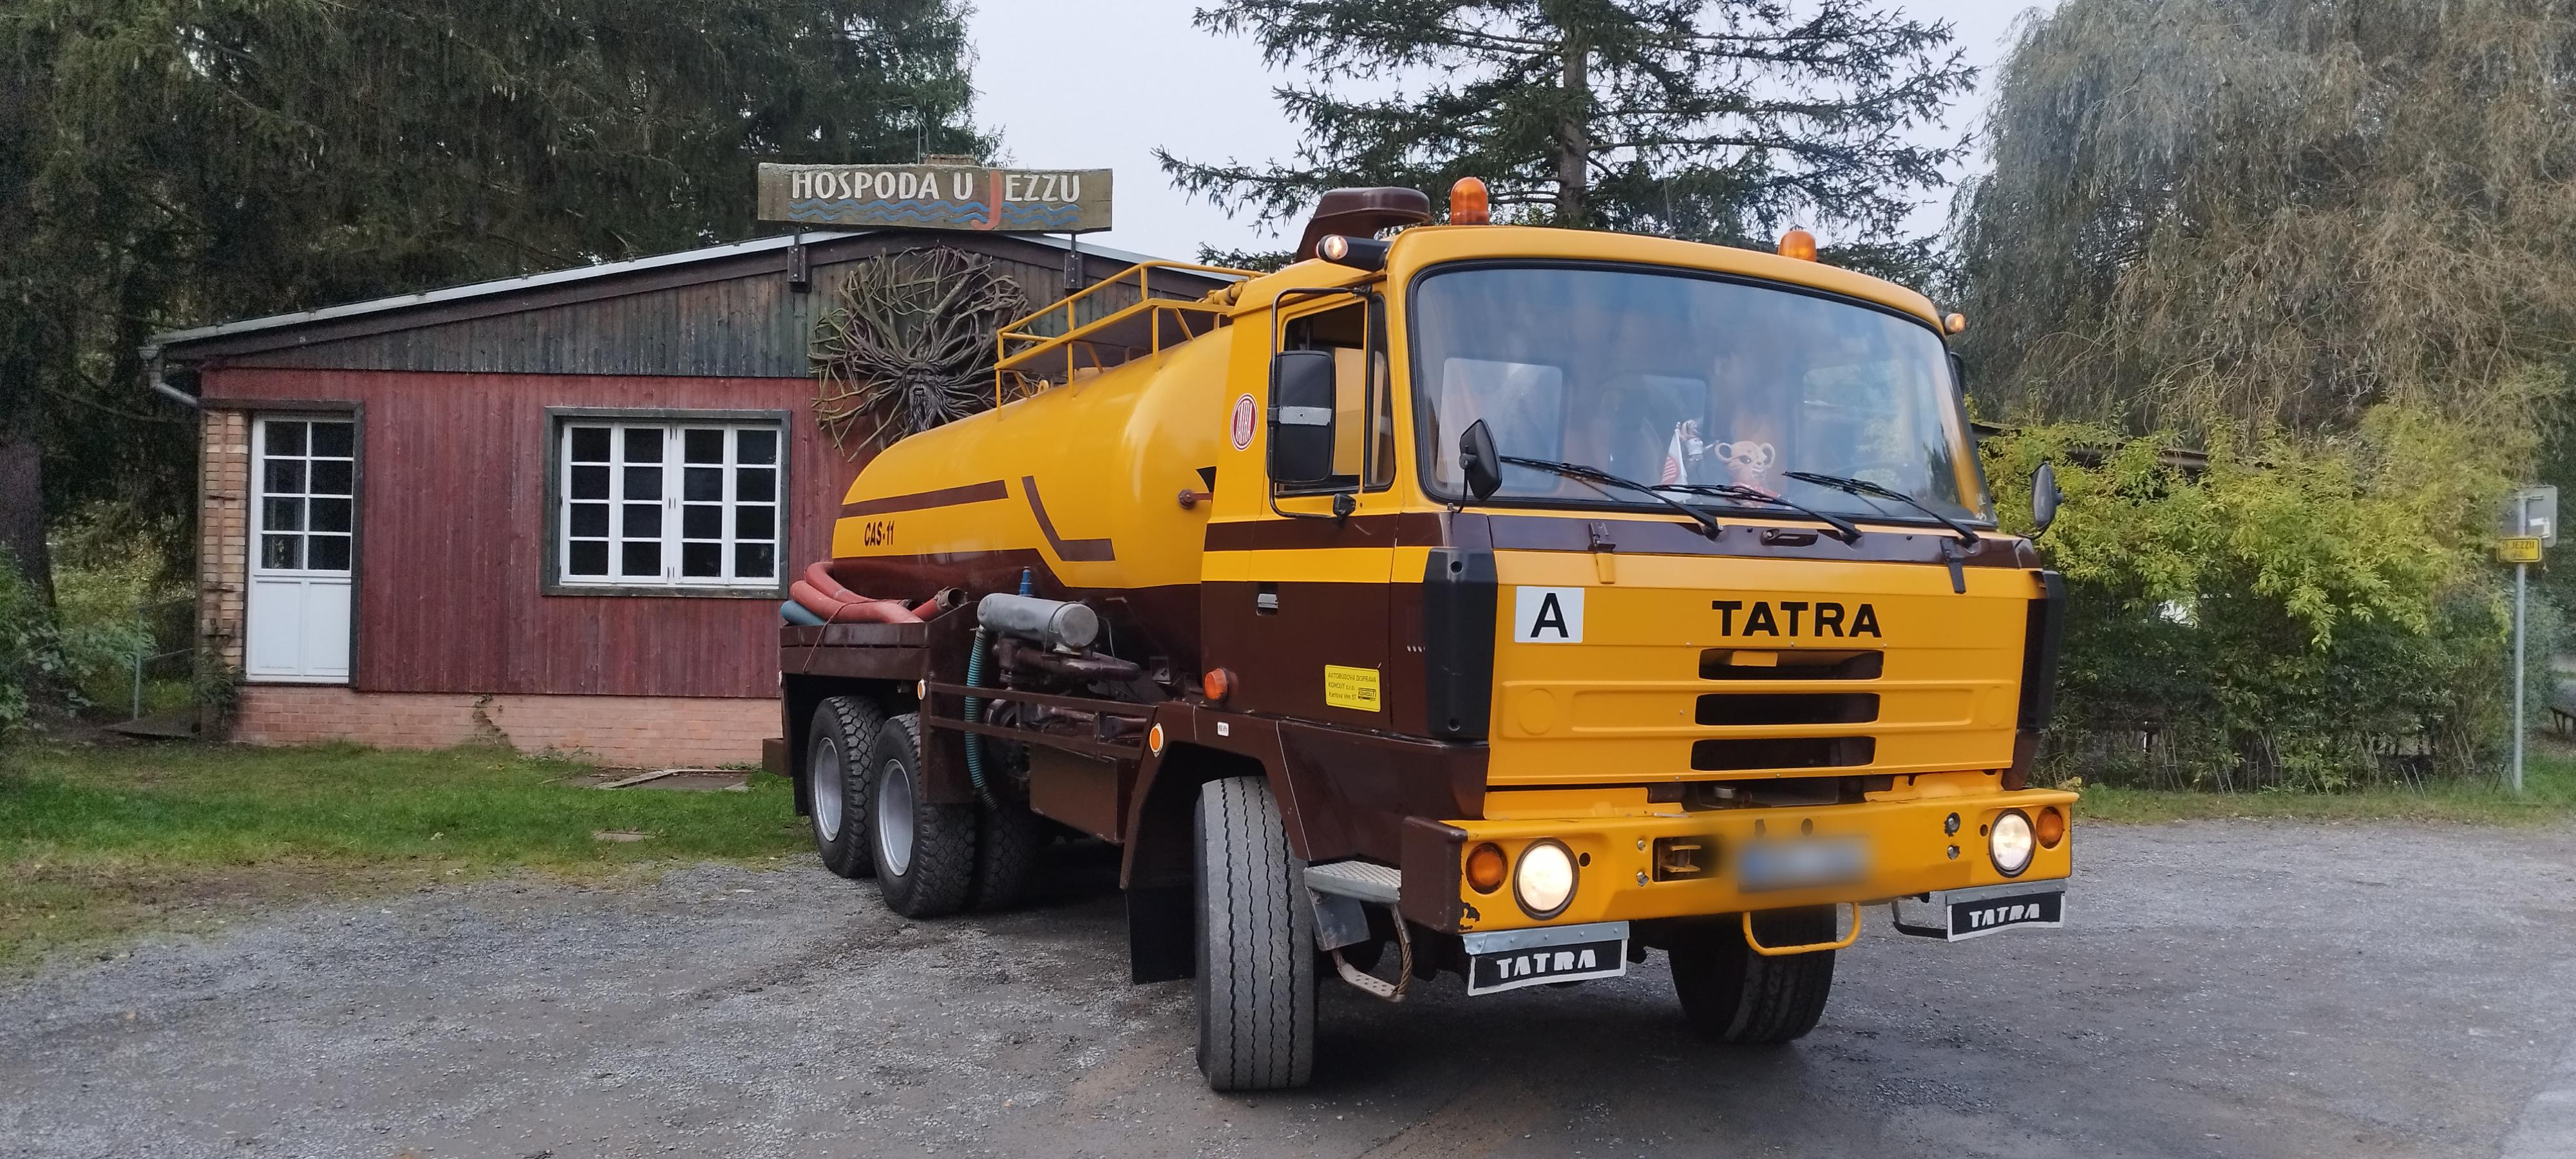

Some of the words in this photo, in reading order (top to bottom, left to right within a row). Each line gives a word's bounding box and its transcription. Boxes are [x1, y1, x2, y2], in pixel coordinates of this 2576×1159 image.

[792, 171, 940, 200] HOSPODA
[954, 172, 973, 200] U
[971, 170, 1080, 231] JEZZU
[1236, 400, 1253, 445] TATRA
[864, 520, 895, 547] CAS-11
[2510, 541, 2534, 549] JEZZU
[1530, 592, 1569, 638] A
[1712, 600, 1882, 638] TATRA
[1969, 903, 2040, 928] TATRA
[1496, 949, 1596, 979] TATRA
